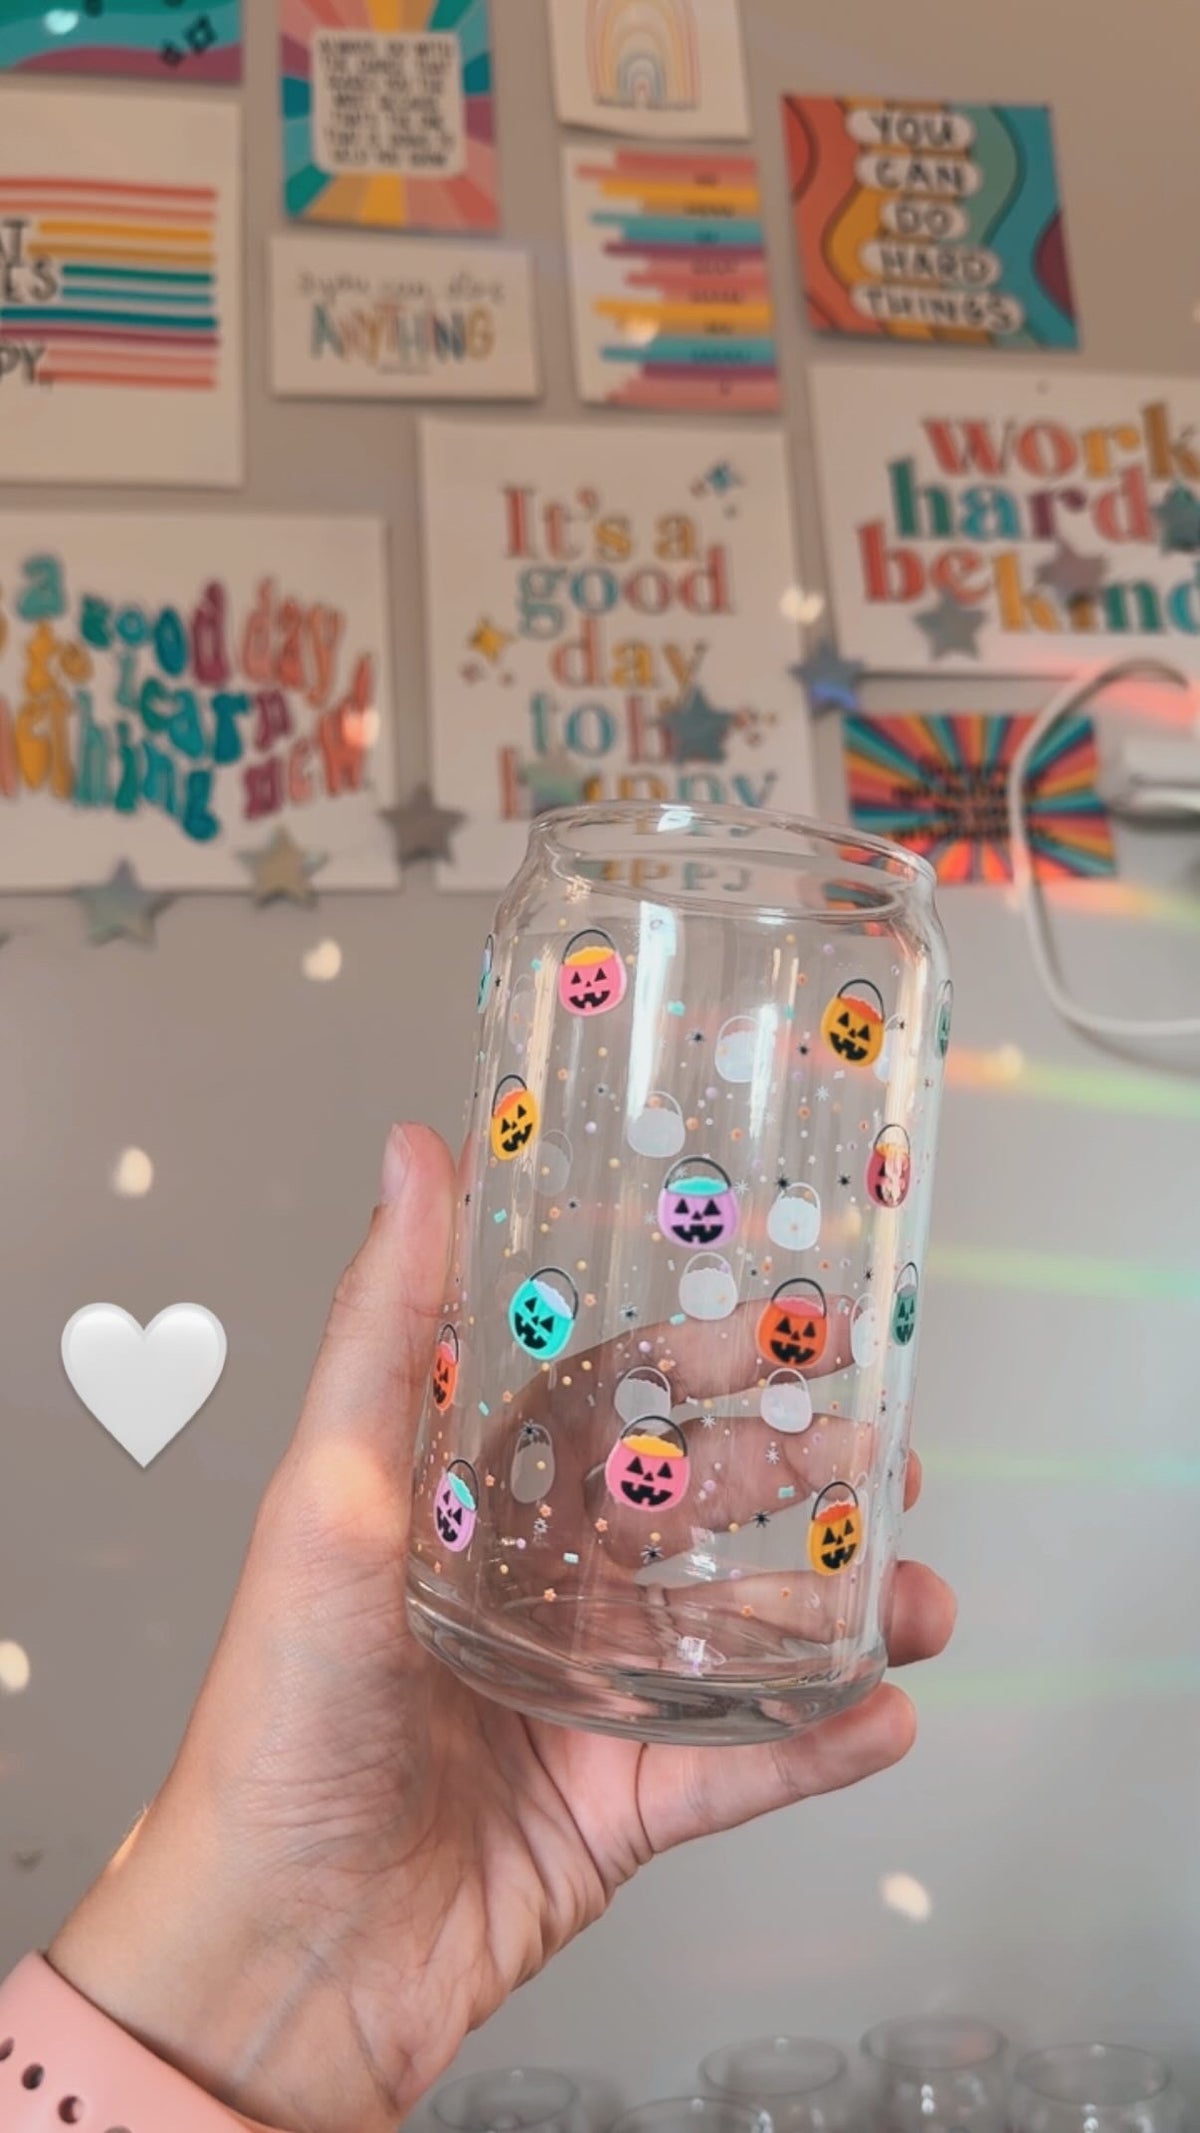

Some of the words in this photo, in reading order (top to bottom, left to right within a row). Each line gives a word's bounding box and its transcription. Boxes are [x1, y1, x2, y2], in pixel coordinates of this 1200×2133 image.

[870, 115, 954, 148] YOU
[874, 155, 963, 191] CAN
[896, 205, 953, 237] DO
[881, 246, 991, 285] HARD
[309, 296, 496, 369] ANYTHING
[866, 287, 1014, 333] THINGS
[923, 402, 1200, 480] work
[503, 485, 634, 562] It's
[654, 512, 697, 561] a
[888, 457, 1156, 543] hard
[517, 544, 734, 640] good
[857, 516, 991, 605] be
[17, 553, 65, 623] a
[80, 576, 230, 689] good
[242, 575, 345, 709] day
[550, 614, 709, 713] day
[243, 652, 374, 821] new
